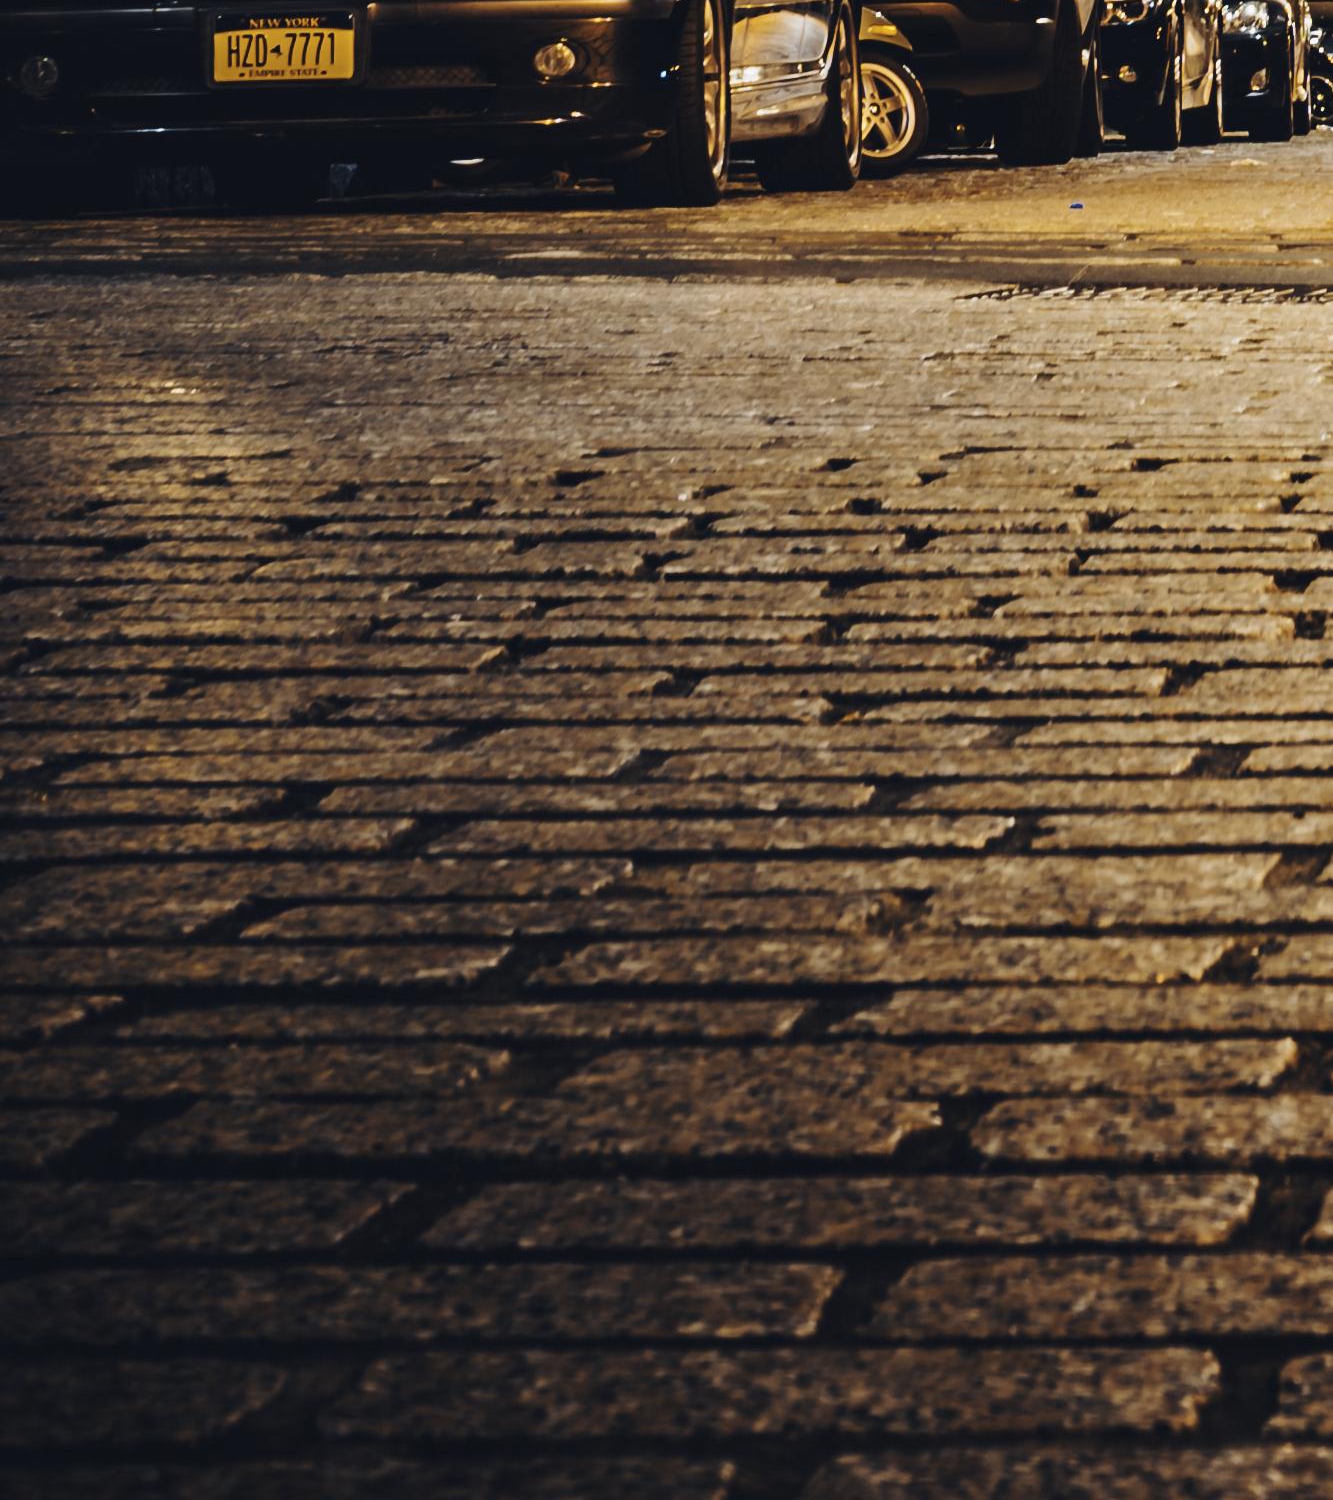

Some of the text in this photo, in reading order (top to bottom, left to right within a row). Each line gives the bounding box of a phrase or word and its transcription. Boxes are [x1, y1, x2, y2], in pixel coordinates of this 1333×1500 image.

[249, 17, 320, 29] NEW YORK
[227, 32, 335, 68] HZD 7771
